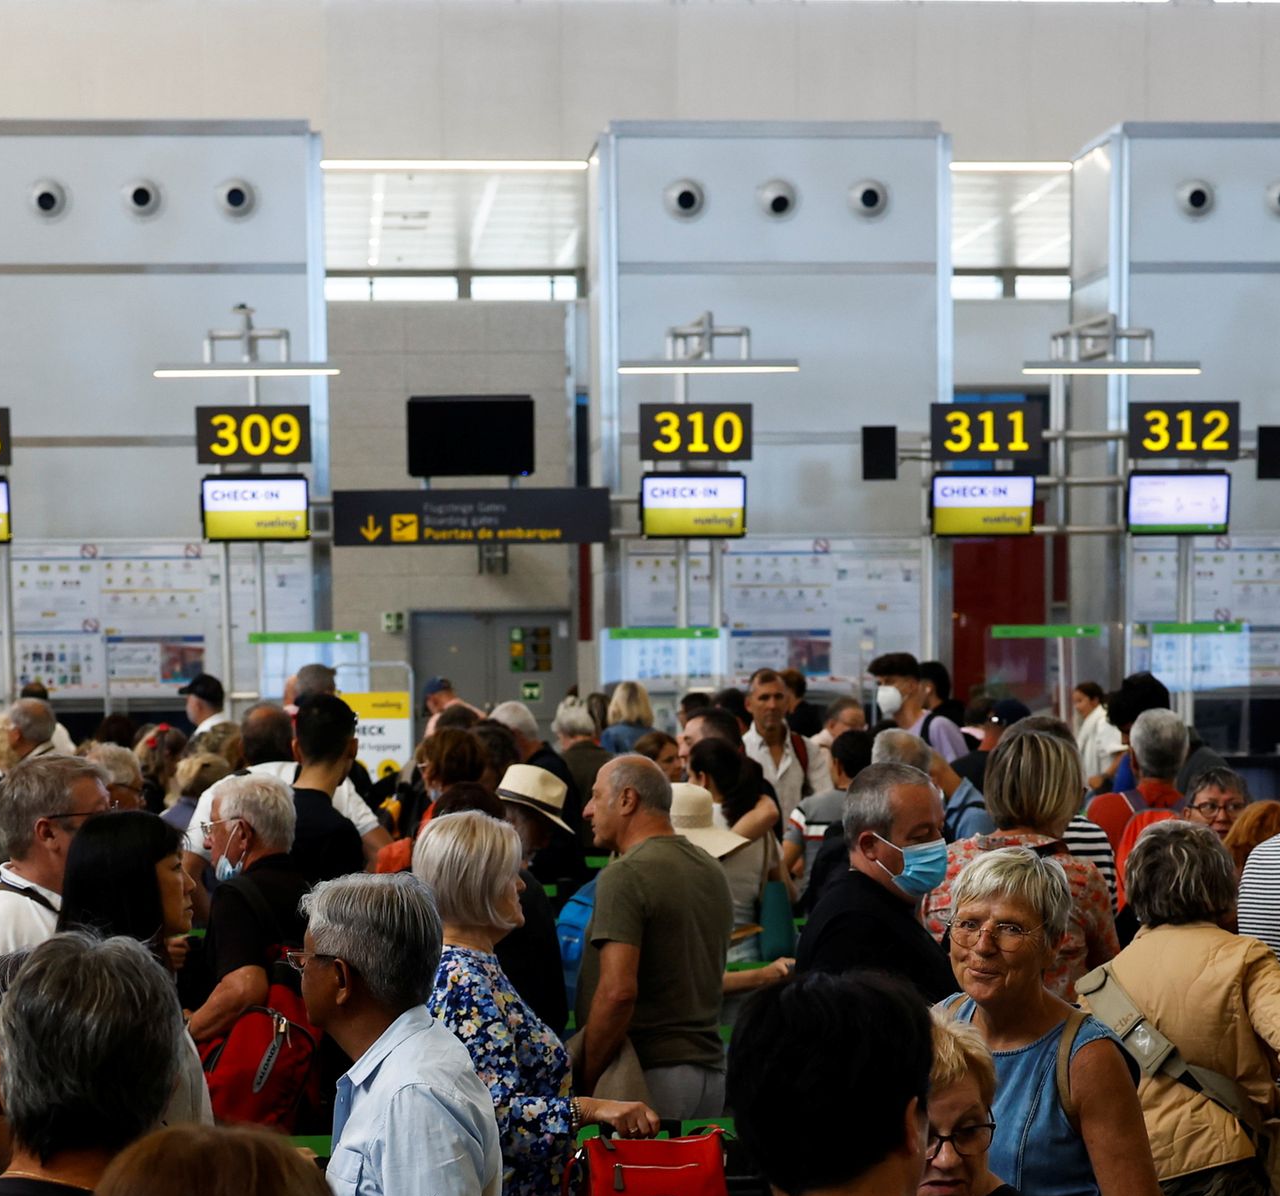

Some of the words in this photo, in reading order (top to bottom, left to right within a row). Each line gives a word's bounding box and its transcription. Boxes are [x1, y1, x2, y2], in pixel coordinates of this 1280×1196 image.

[210, 413, 302, 456] 309
[652, 411, 743, 454] 310
[943, 411, 1029, 453] 311
[1142, 409, 1231, 452] 312
[211, 490, 280, 501] CHECK-IN
[650, 487, 719, 498] CHECK-IN
[941, 486, 1008, 497] CHECK-IN
[256, 517, 297, 530] vueling
[423, 514, 468, 526] Boarding
[471, 515, 498, 527] gates
[693, 515, 734, 528] vueling
[982, 514, 1023, 526] vueling
[424, 527, 473, 540] Puertas
[477, 526, 494, 540] de
[497, 526, 561, 541] embarque
